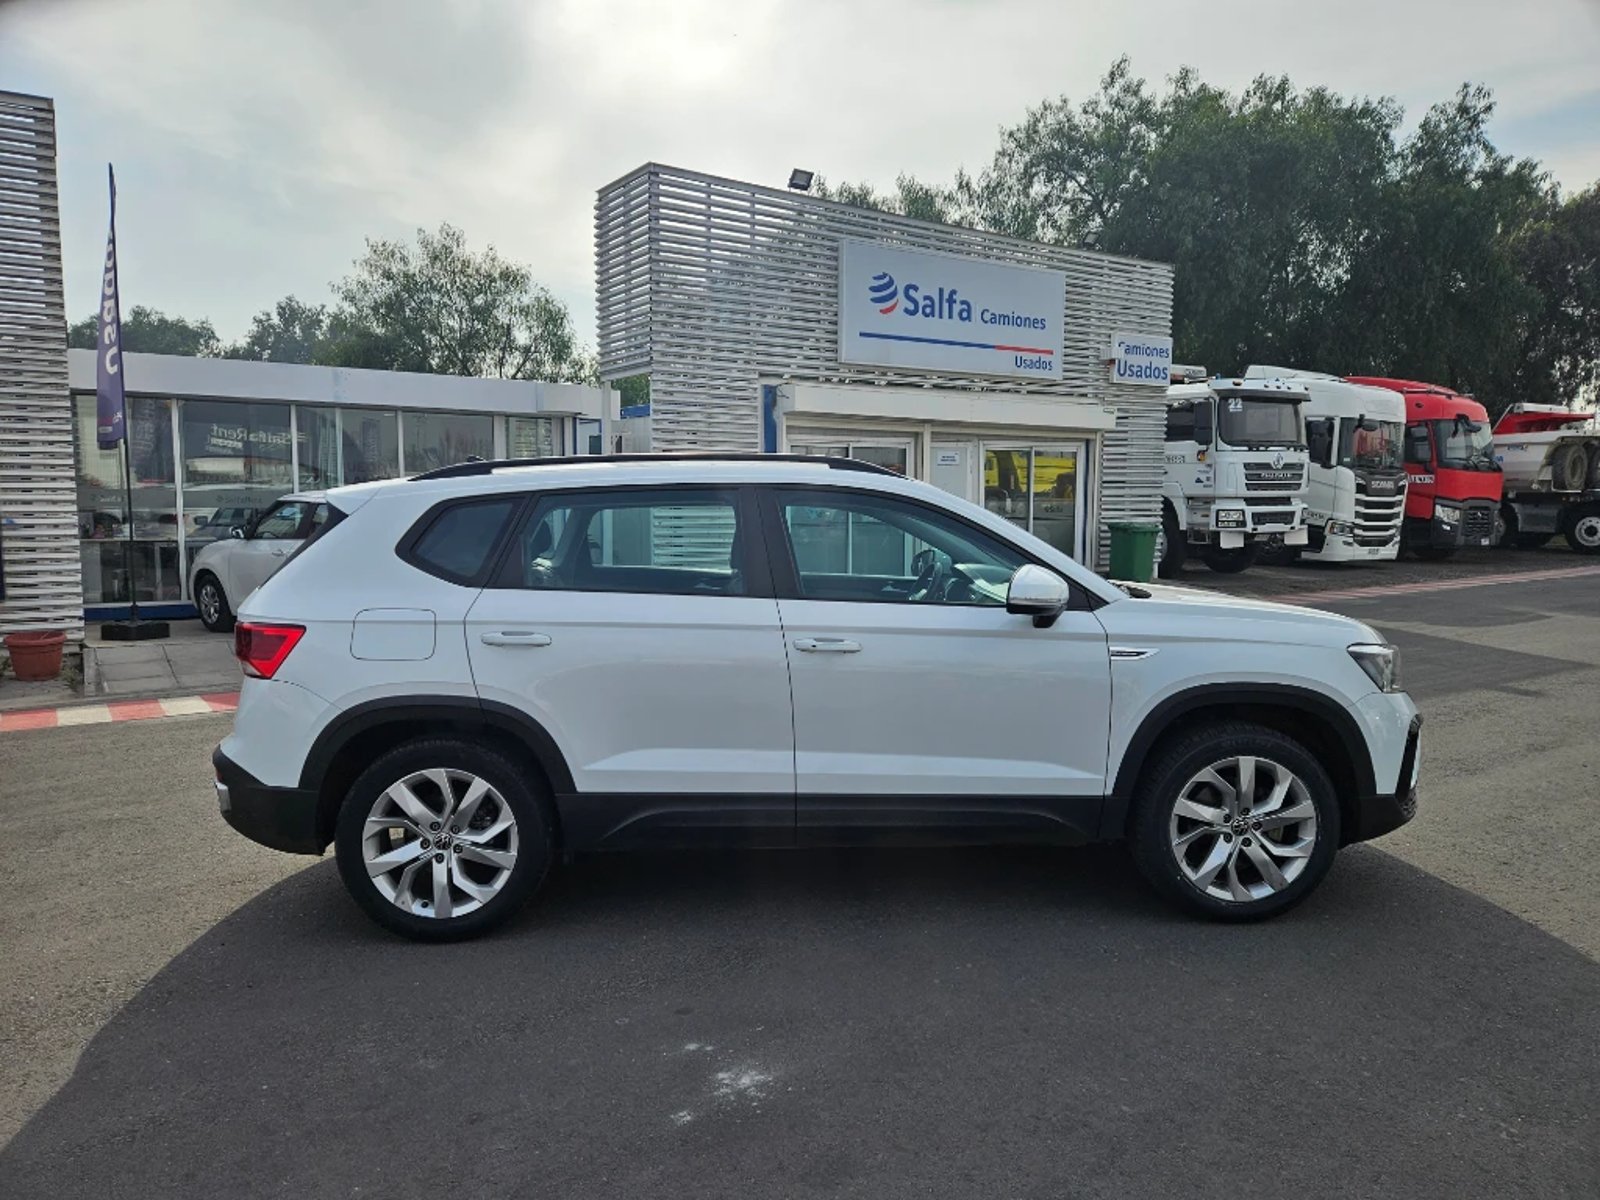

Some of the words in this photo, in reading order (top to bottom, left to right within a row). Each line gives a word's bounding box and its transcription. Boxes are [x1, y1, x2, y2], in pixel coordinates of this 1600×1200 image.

[903, 283, 973, 323] Salfa
[980, 308, 1047, 331] Camiones
[1014, 355, 1053, 372] Usados
[1117, 360, 1168, 380] Usados
